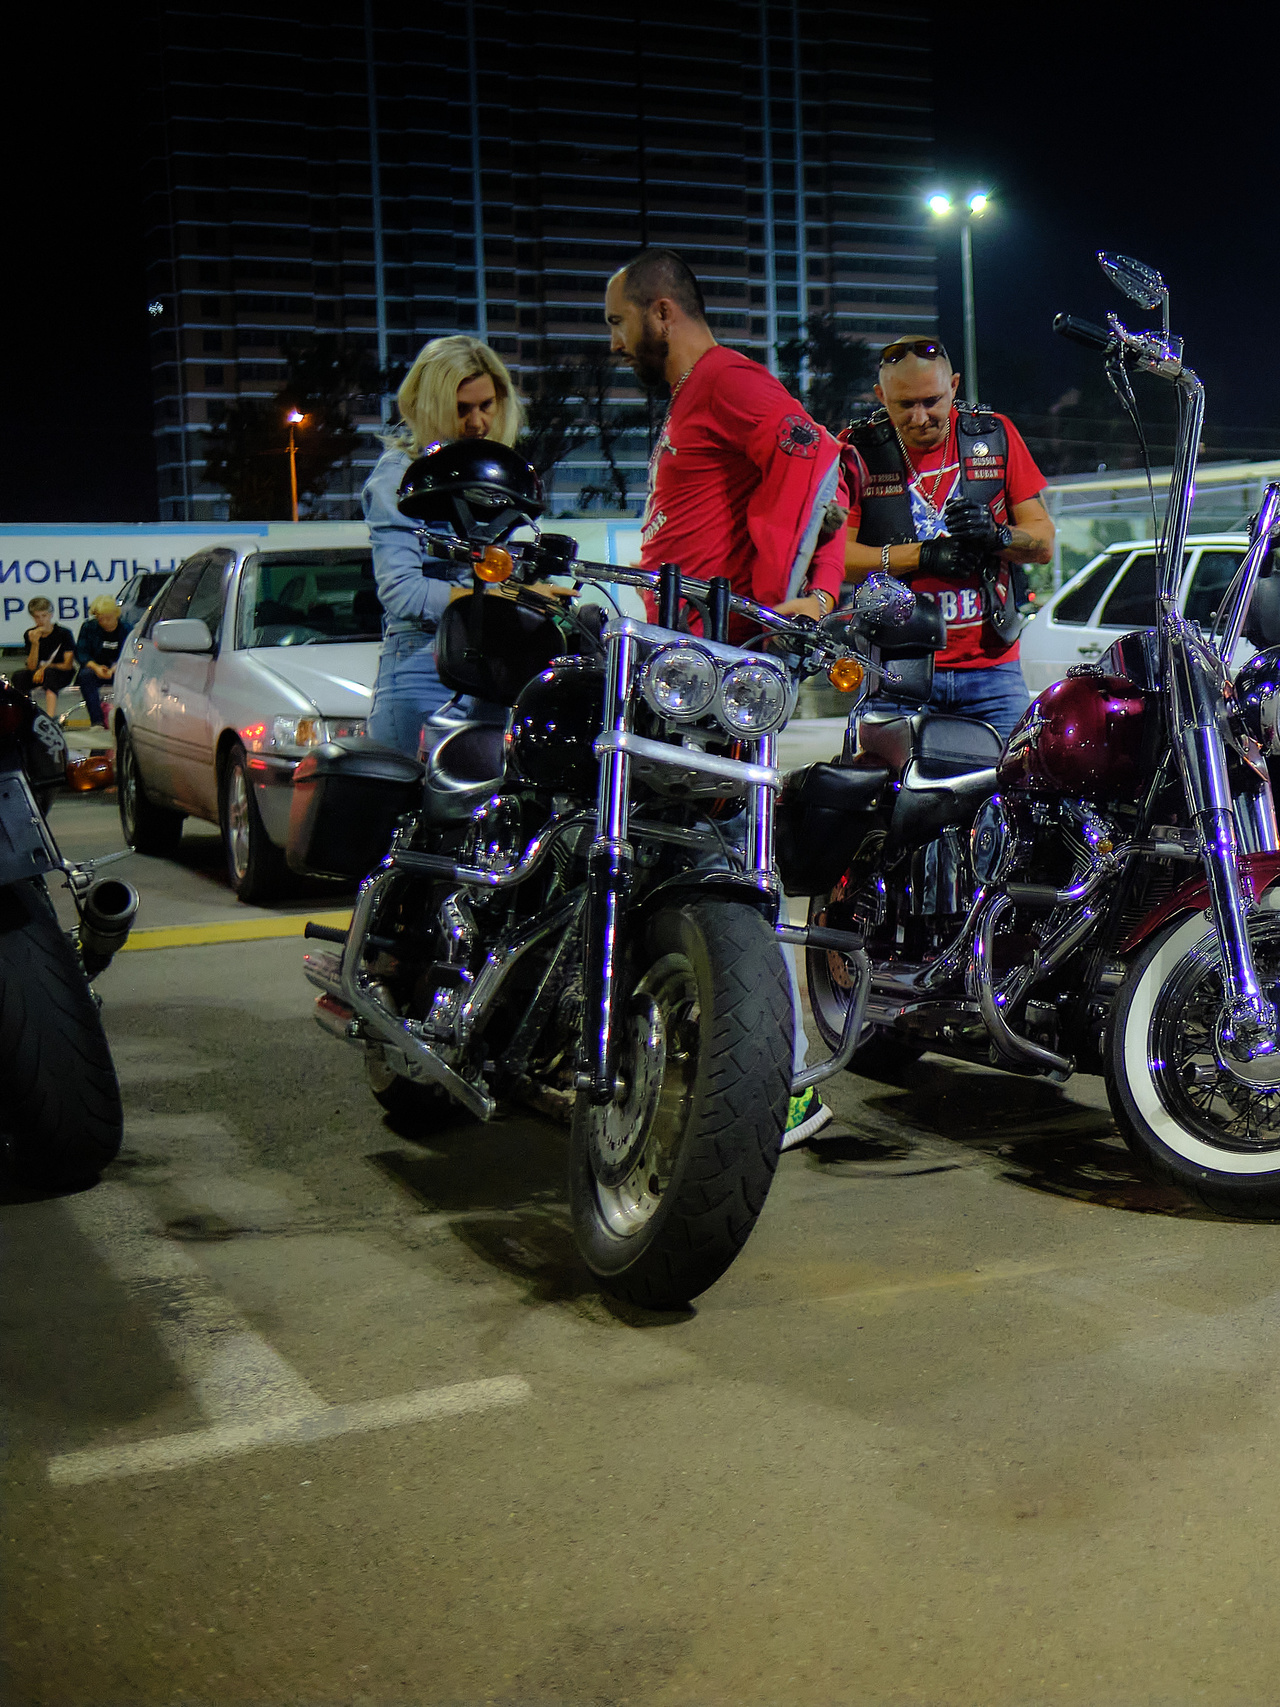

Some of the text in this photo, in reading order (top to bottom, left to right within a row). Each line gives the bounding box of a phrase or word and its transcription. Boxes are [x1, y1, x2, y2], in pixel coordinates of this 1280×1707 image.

[972, 456, 997, 467] RUSSIA
[974, 469, 999, 479] KUBAN
[0, 559, 187, 583] ИОНАЛЬН
